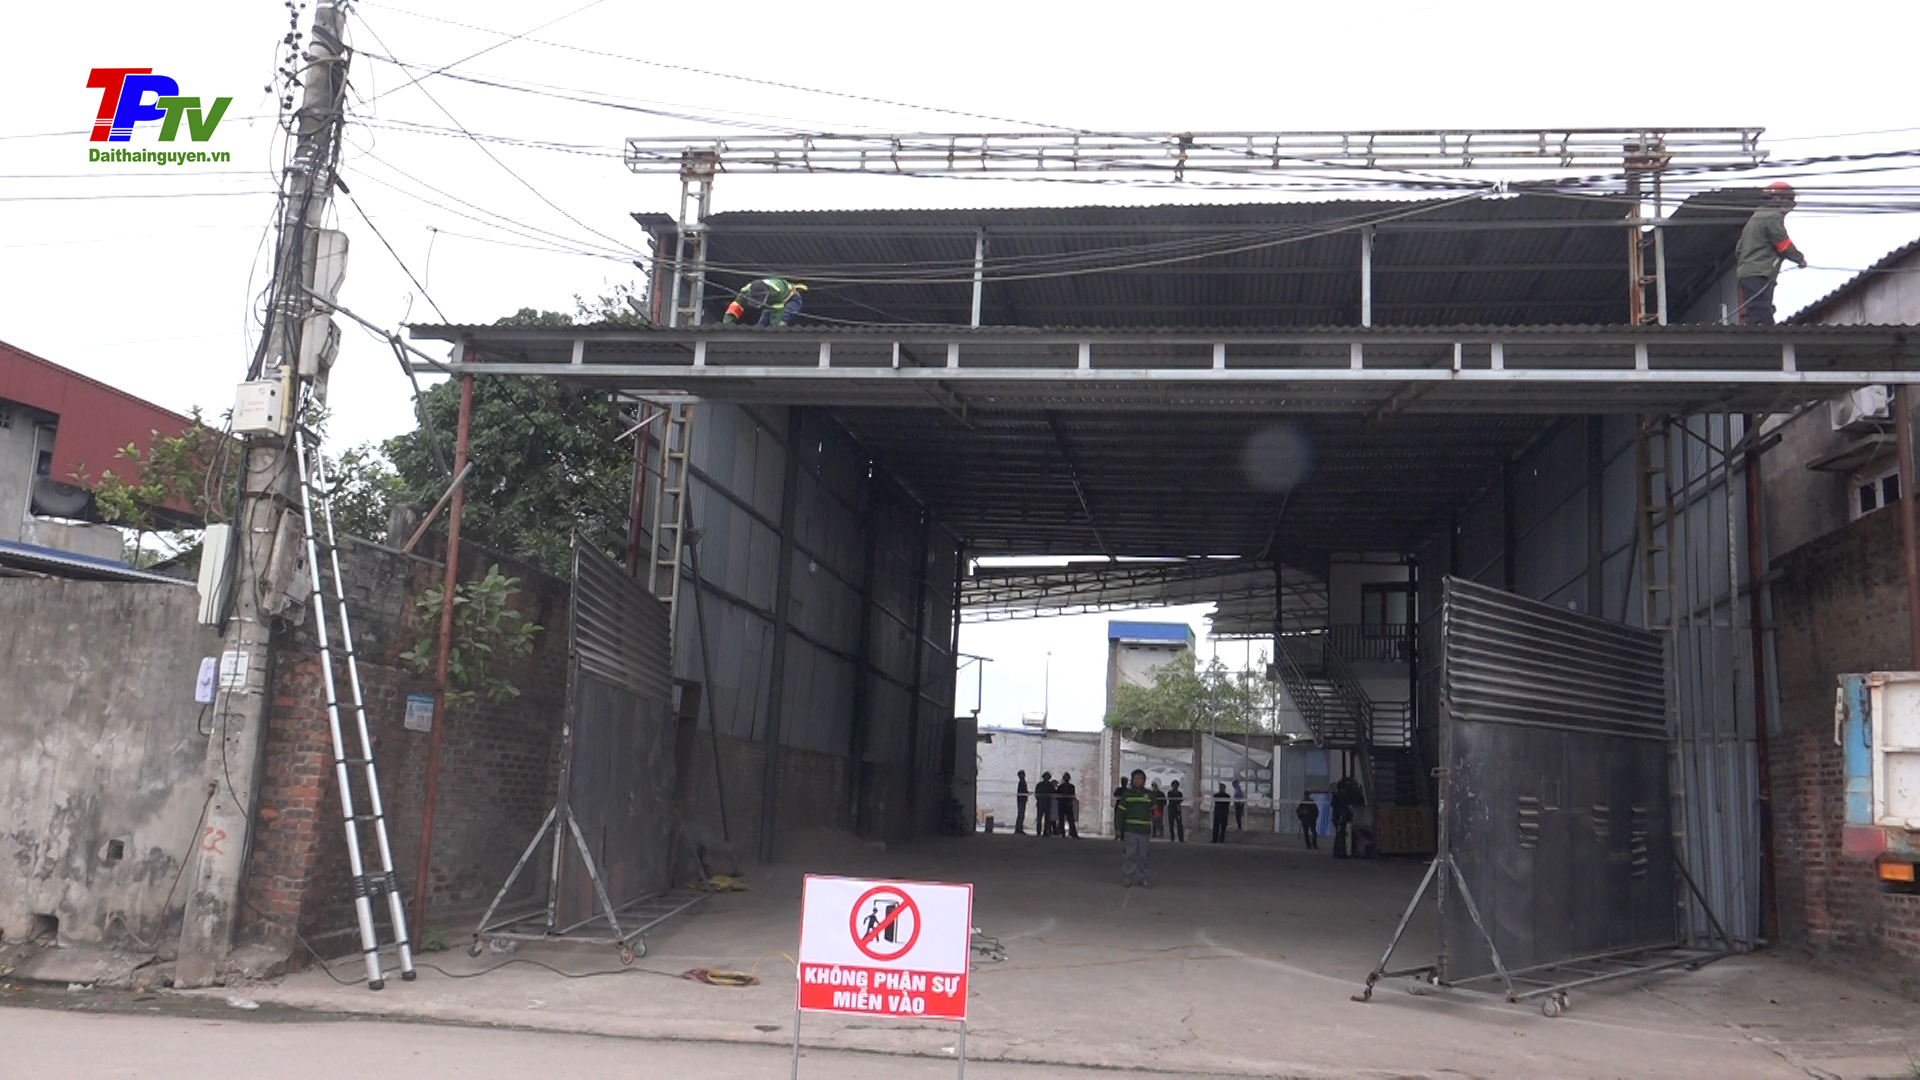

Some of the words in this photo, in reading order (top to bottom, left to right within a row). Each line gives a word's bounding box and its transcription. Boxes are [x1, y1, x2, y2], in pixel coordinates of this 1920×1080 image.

[805, 965, 868, 988] KHÔNG
[931, 975, 960, 998] SỰ
[888, 991, 925, 1014] VÀO
